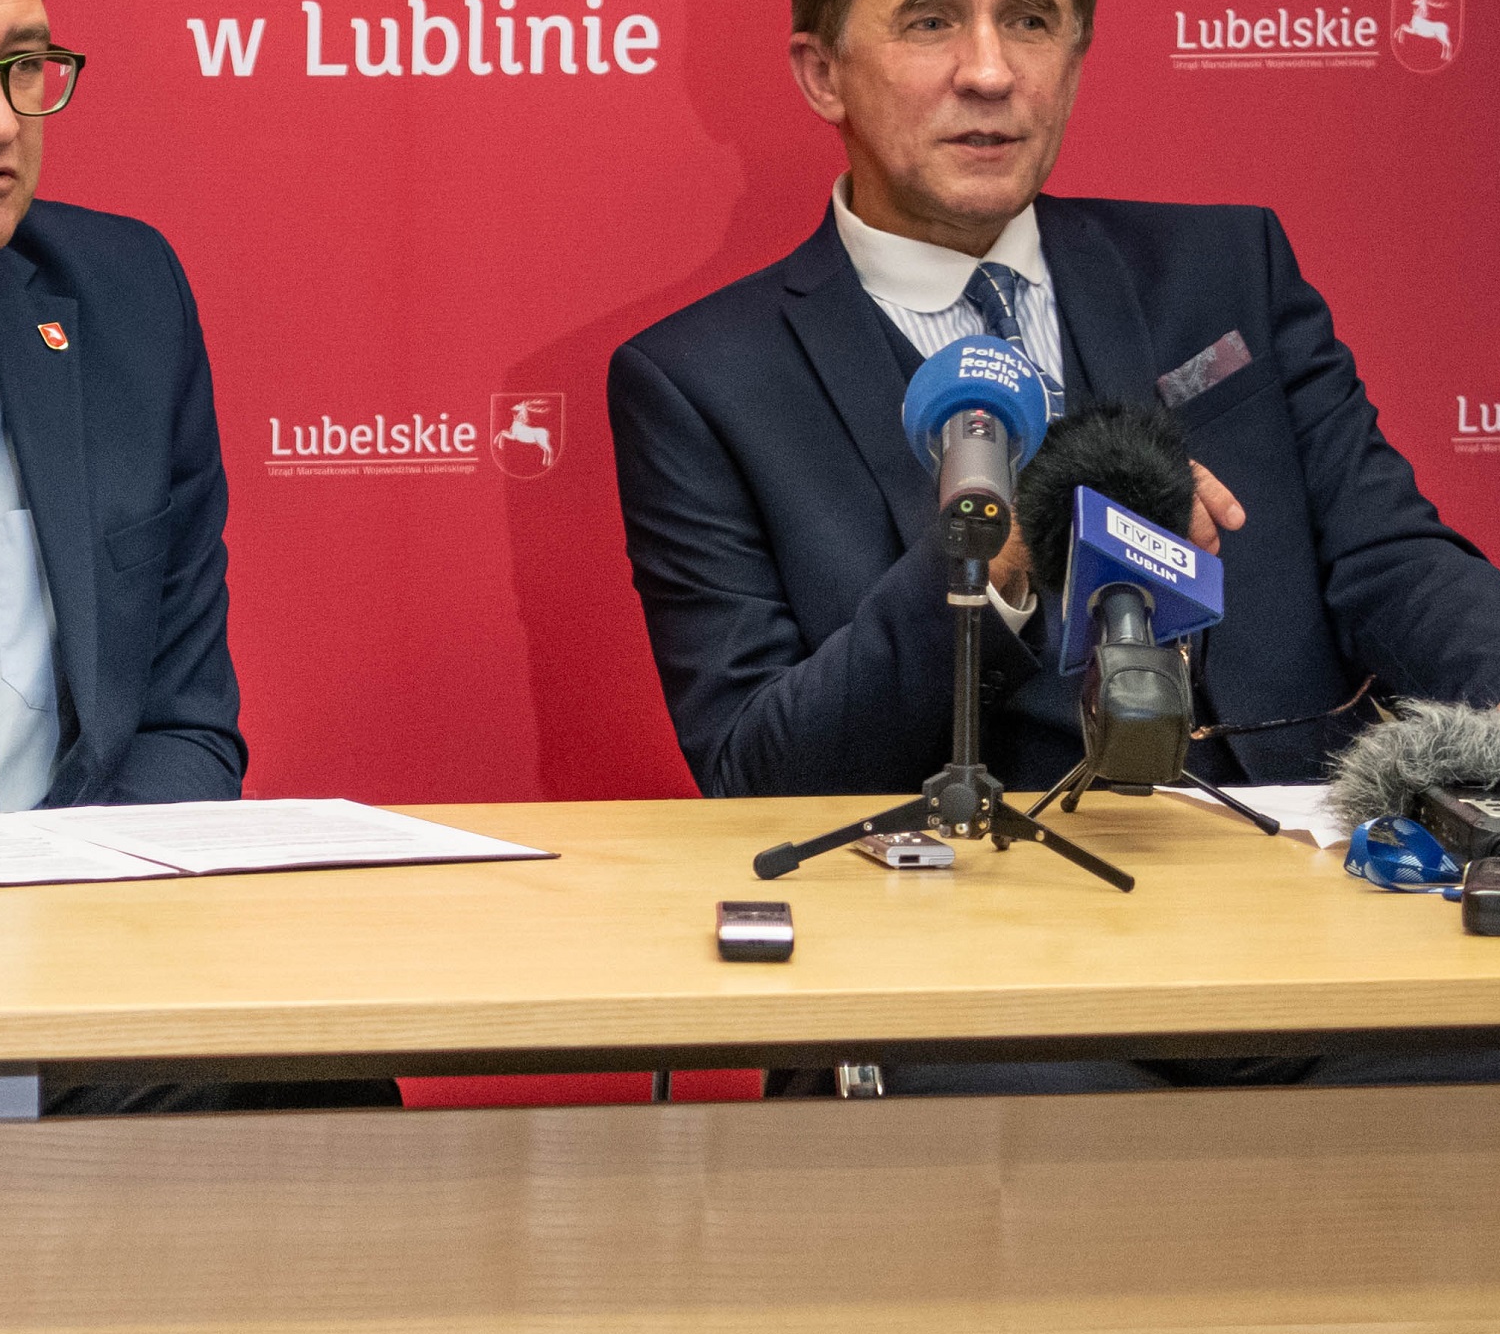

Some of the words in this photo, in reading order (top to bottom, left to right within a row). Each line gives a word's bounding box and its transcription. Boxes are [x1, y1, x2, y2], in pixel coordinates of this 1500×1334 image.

[1175, 7, 1378, 49] Lubelskie
[186, 18, 265, 77] w
[959, 368, 1020, 393] Lublin
[961, 357, 1019, 380] Radio
[962, 347, 1032, 378] Polskie
[269, 413, 476, 456] Lubelskie
[1125, 547, 1178, 584] LUBLIN
